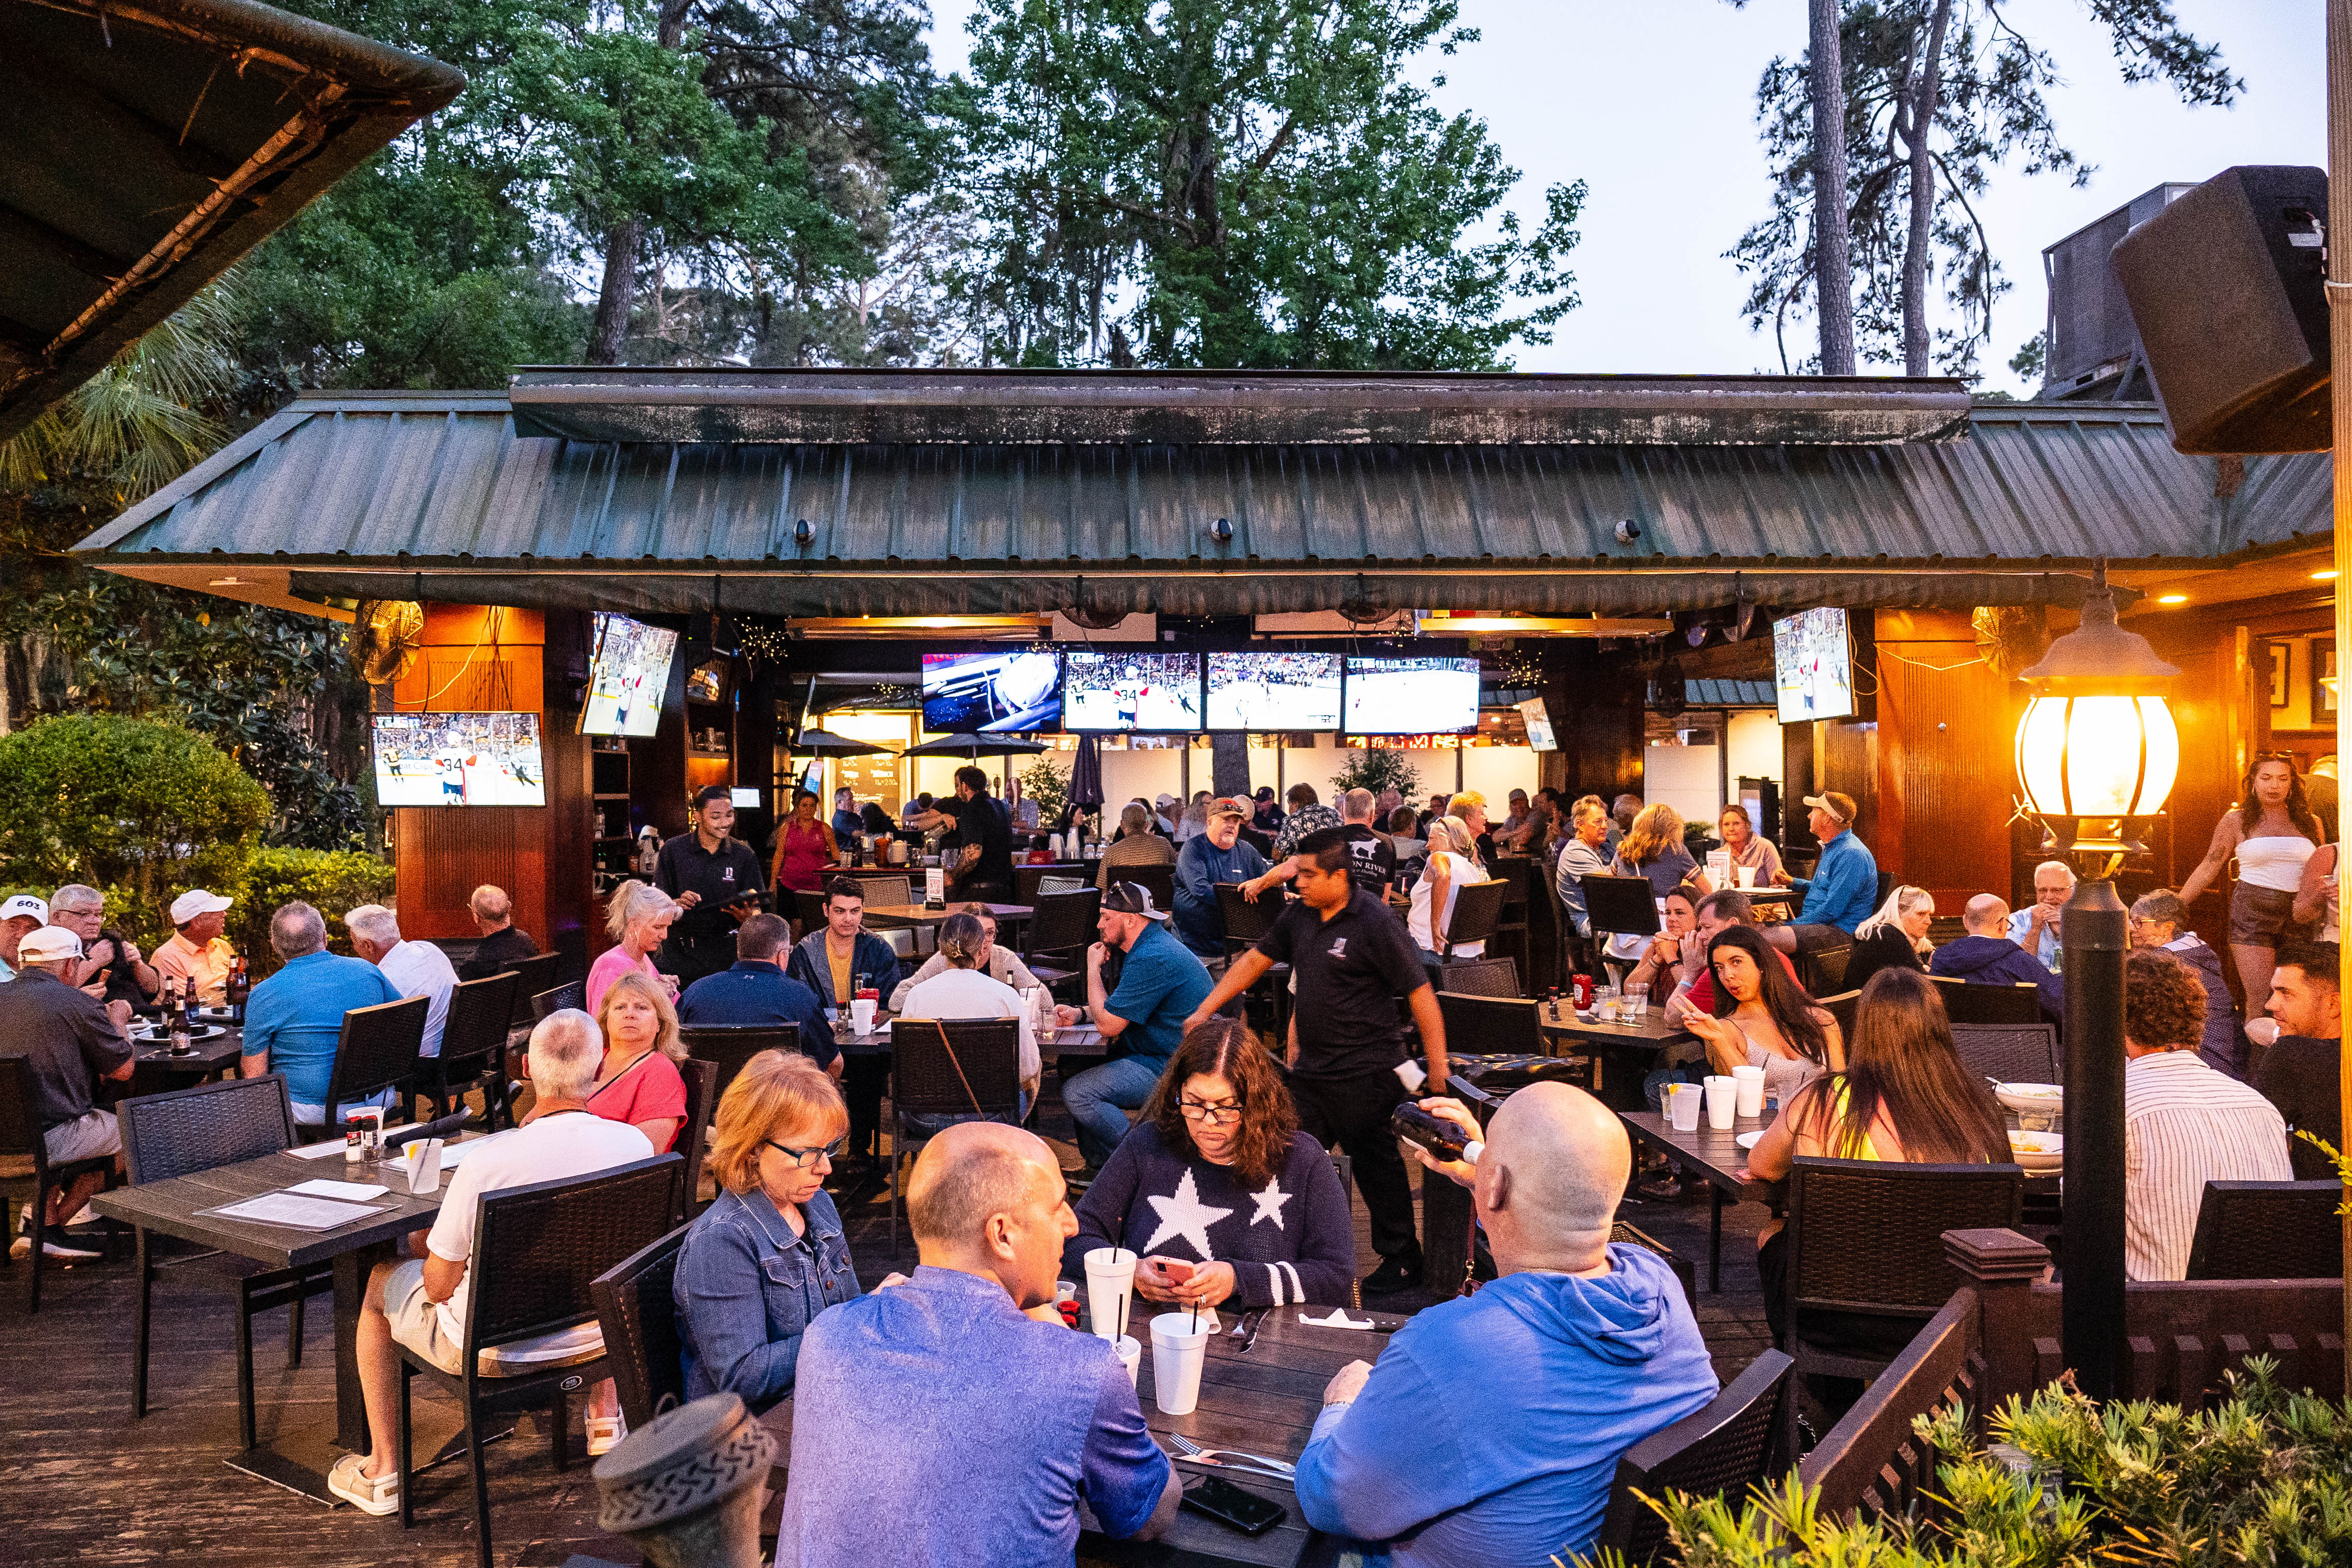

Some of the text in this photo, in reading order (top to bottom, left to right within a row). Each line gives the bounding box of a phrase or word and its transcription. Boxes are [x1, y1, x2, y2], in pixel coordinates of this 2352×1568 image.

[1121, 690, 1136, 701] 34
[413, 762, 433, 772] Clips
[443, 758, 462, 771] 34
[1365, 862, 1386, 875] RIVER
[17, 900, 40, 910] 603
